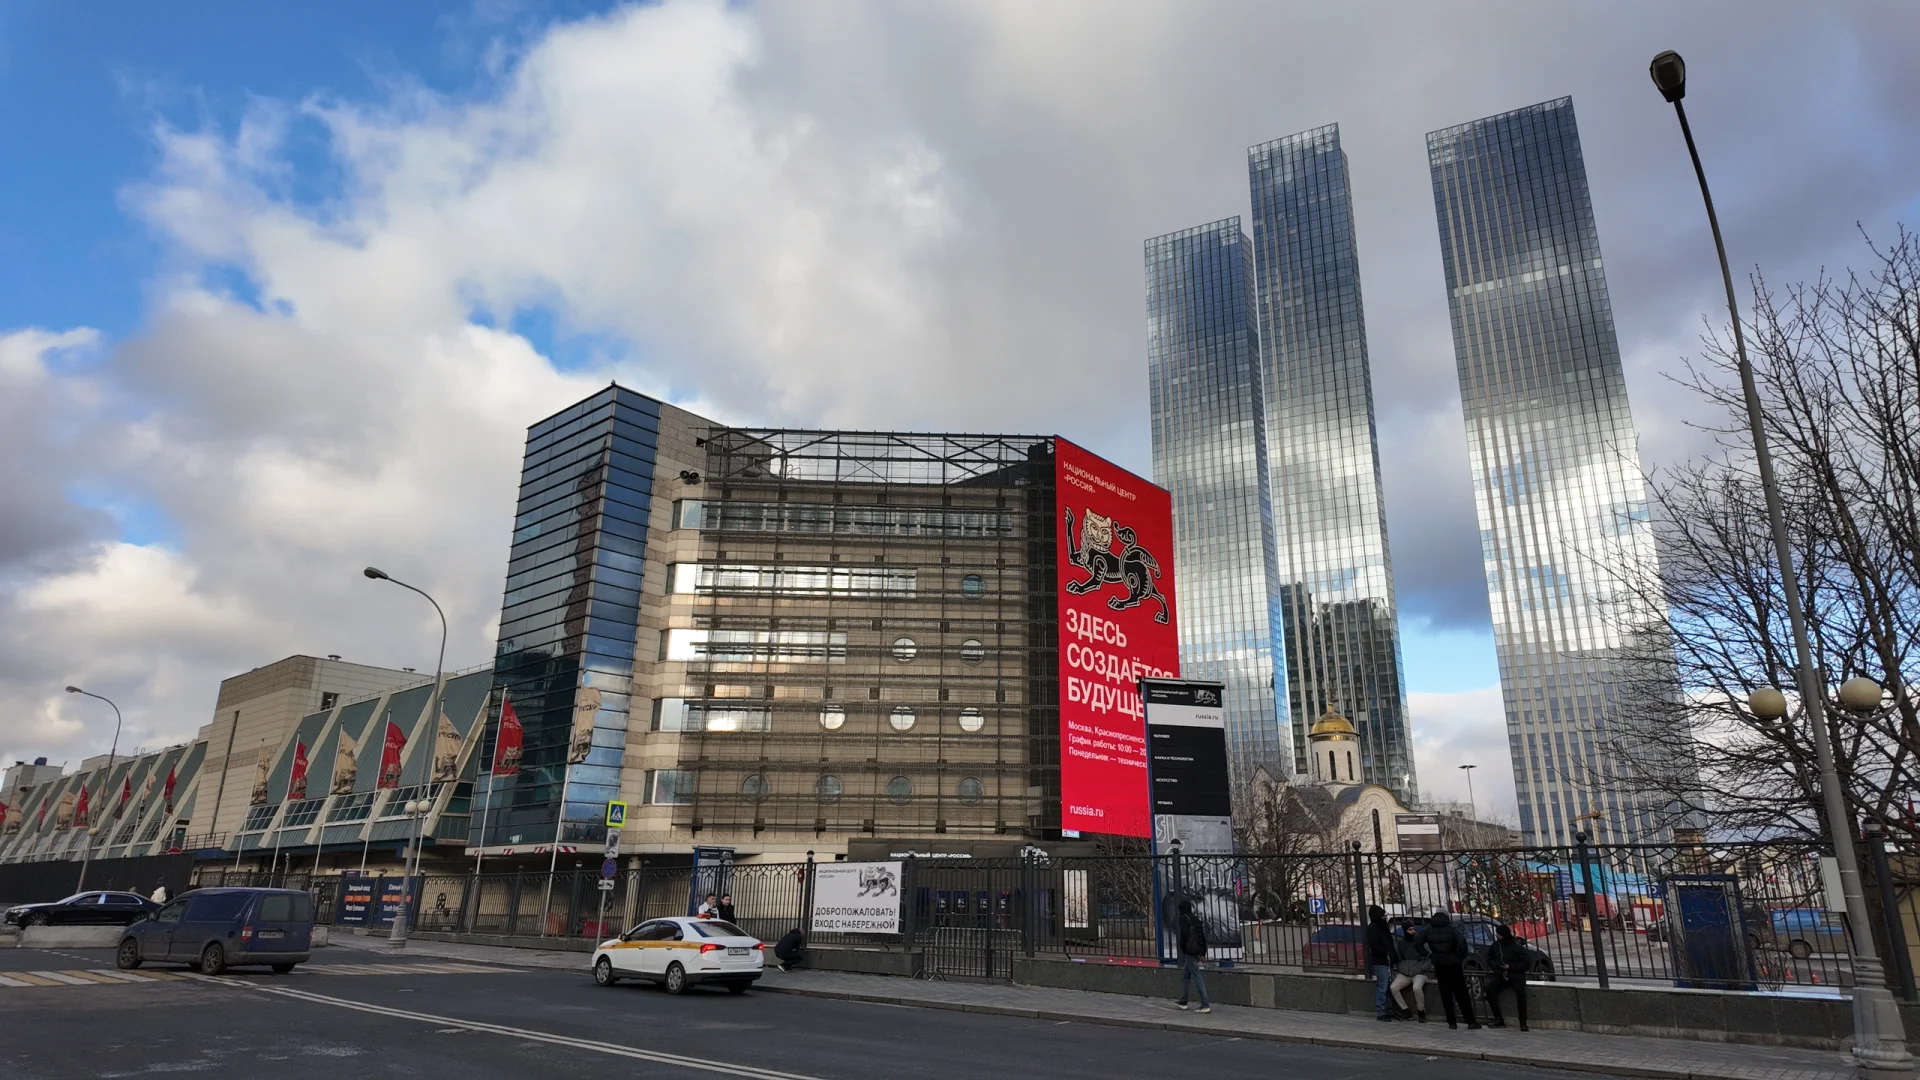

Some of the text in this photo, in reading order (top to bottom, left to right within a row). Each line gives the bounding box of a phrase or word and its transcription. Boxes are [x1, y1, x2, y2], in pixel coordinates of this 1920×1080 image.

[1063, 461, 1136, 501] НАЦИОНАЛЬНЫЙ ЦЕНТР
[1064, 474, 1095, 493] «РОССИЯ»
[1066, 608, 1127, 647] ЗДЕСЬ
[1068, 720, 1094, 734] Москва,
[1068, 733, 1091, 745] График
[1117, 744, 1132, 754] 10:00
[1068, 746, 1109, 762] Понедельник
[1070, 805, 1104, 817] russia.ru
[815, 907, 896, 916] ДОБРО ПОЖАЛОВАТЬ!
[815, 919, 895, 929] ВХОД С НАБЕРЕЖНОЙ
